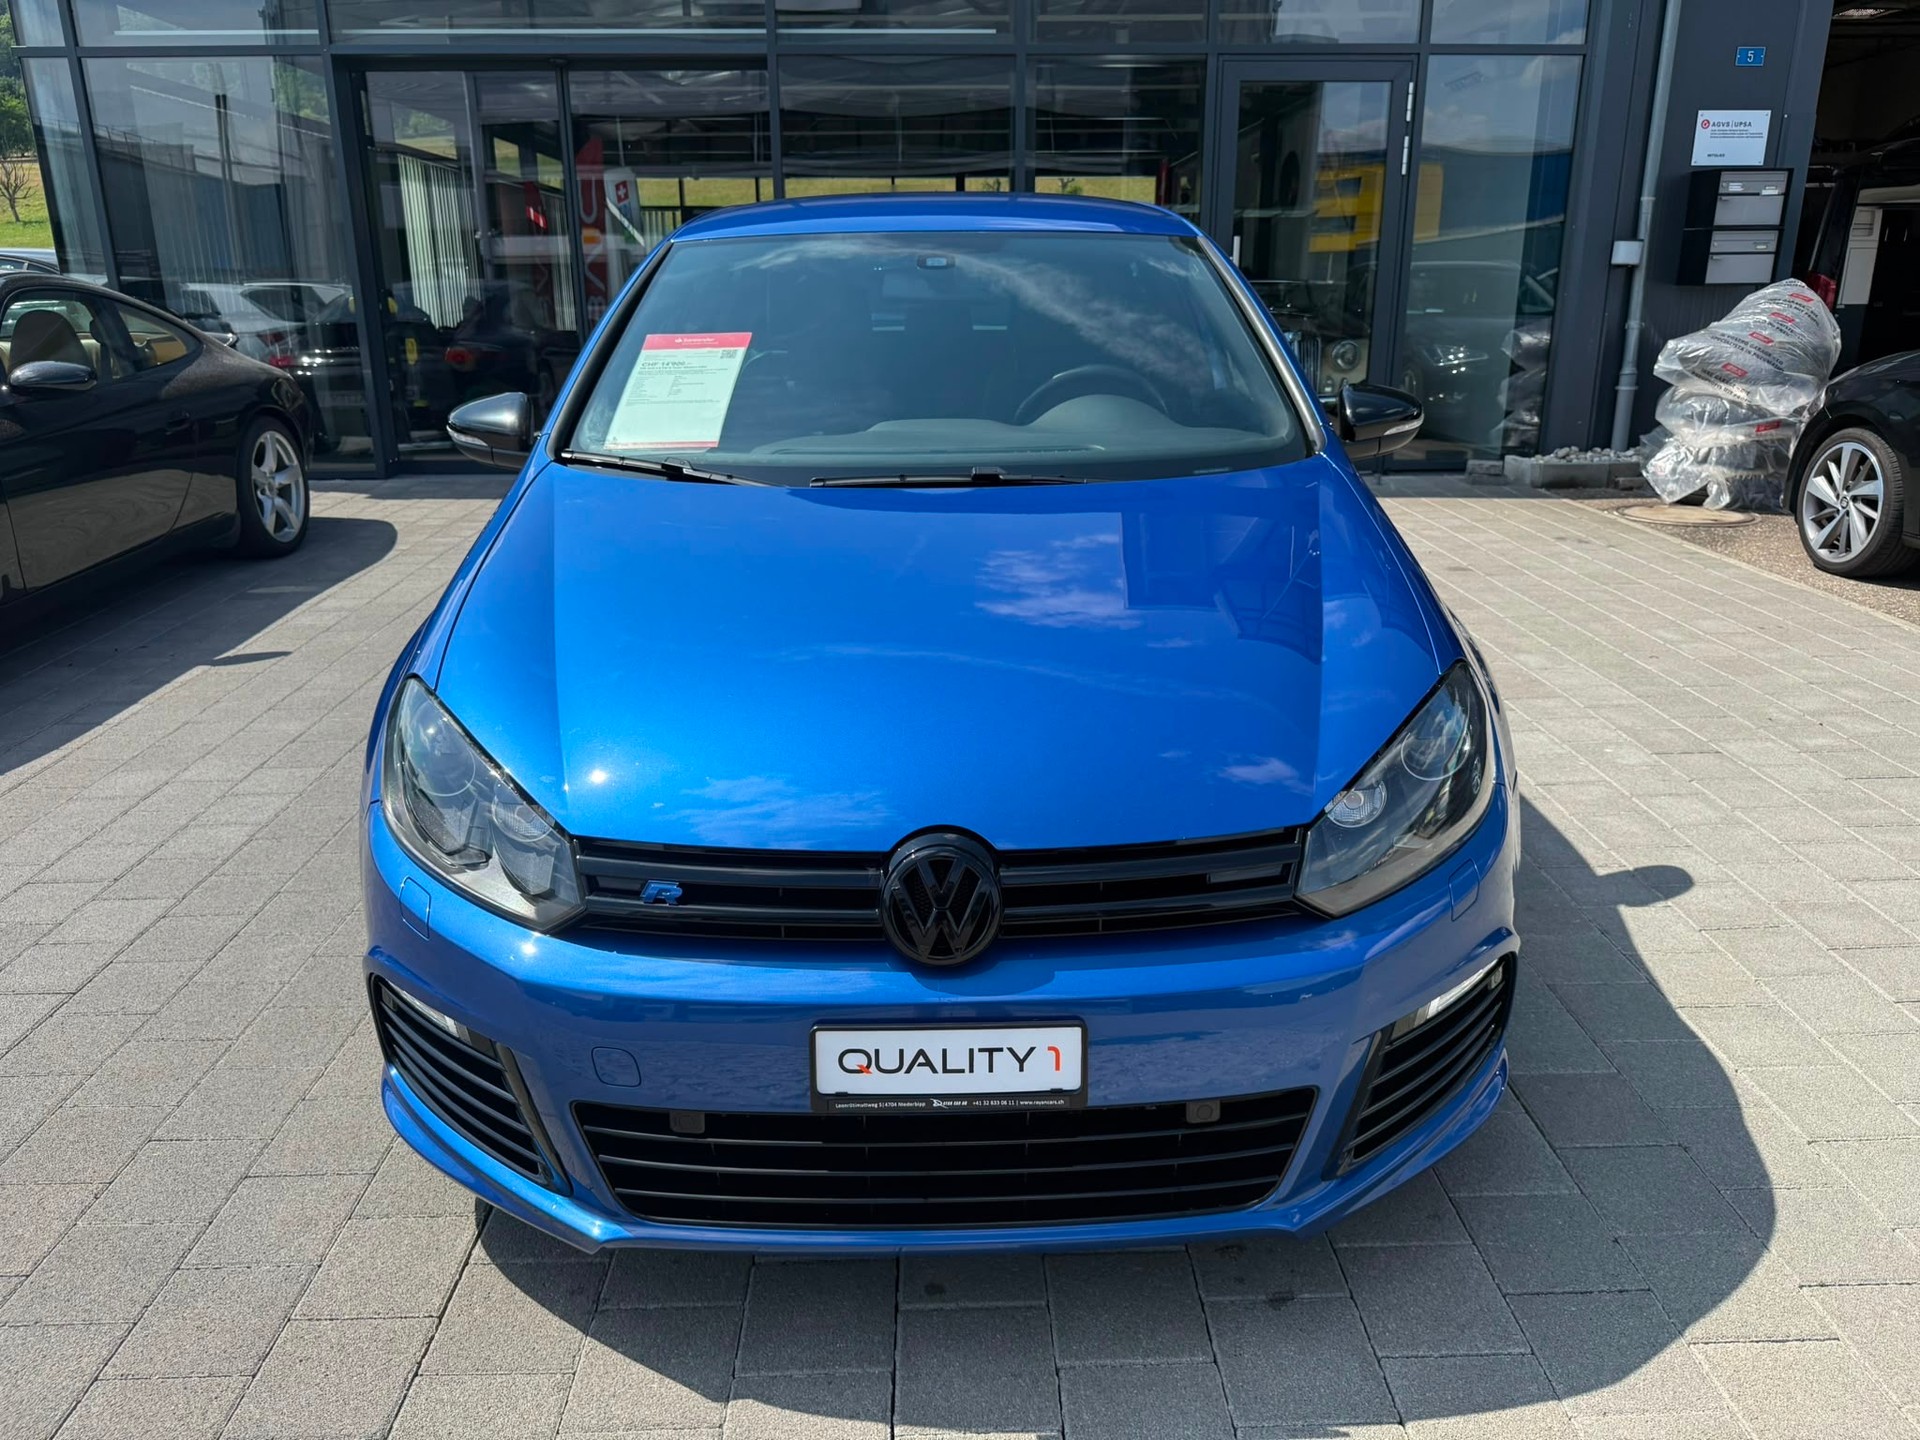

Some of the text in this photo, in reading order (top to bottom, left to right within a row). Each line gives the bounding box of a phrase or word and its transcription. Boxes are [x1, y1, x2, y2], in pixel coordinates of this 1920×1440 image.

[1747, 50, 1755, 63] 5
[1711, 120, 1753, 128] AGVS UPSA
[640, 879, 683, 905] R
[837, 1045, 1061, 1075] QUALITY 1
[898, 1101, 926, 1109] Niederbipp
